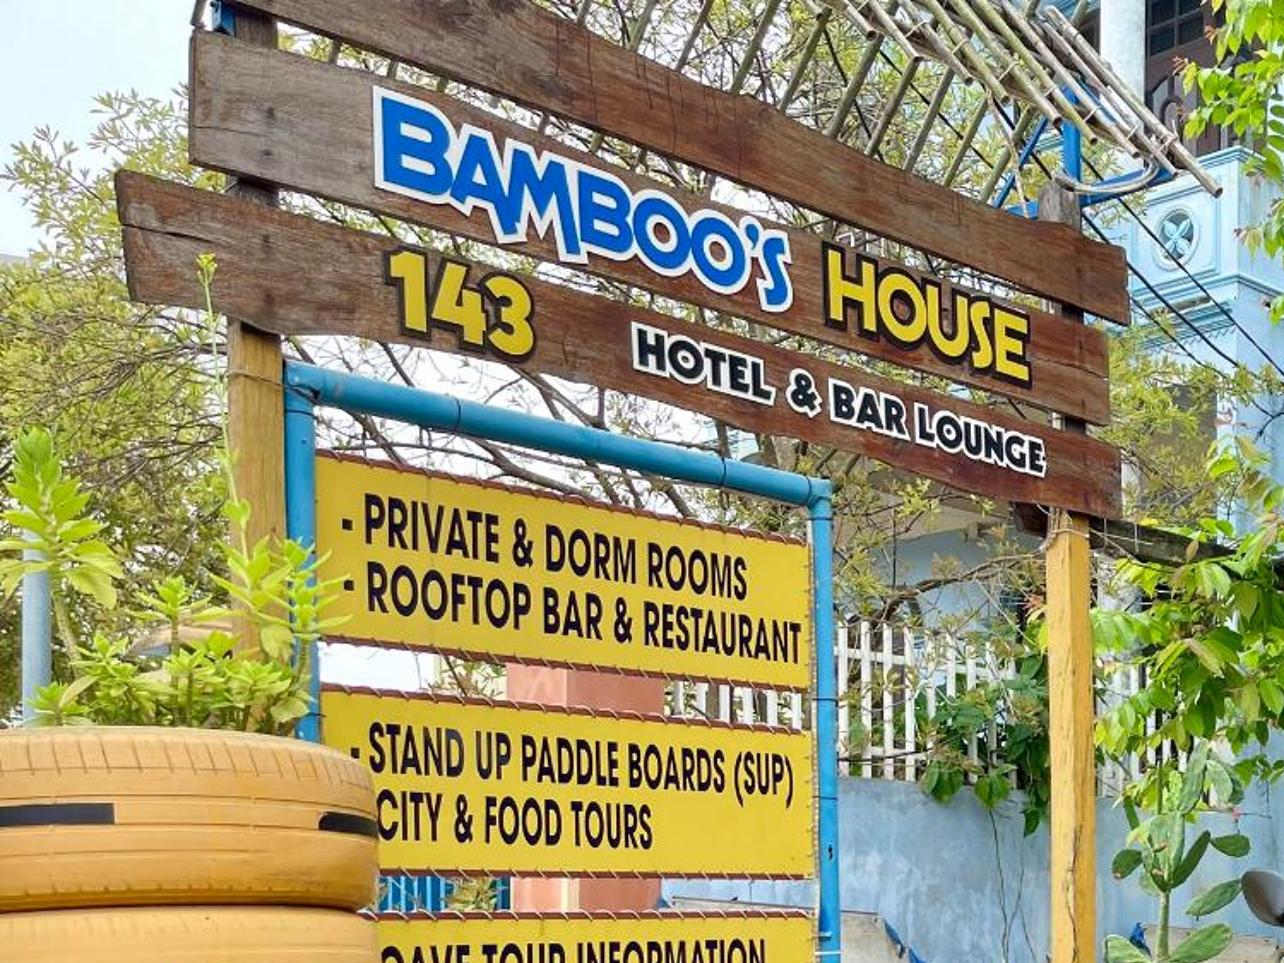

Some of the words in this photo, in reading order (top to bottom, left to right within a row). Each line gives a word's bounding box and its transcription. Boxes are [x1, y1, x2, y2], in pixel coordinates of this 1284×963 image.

[380, 94, 791, 308] BAMBOO'S
[827, 249, 1030, 381] HOUSE
[389, 250, 534, 356] 143
[636, 327, 772, 401] HOTEL
[789, 372, 818, 412] &
[832, 382, 907, 435] BAR
[917, 406, 1045, 474] LOUNGE
[364, 492, 500, 564] PRIVATE
[512, 518, 534, 568] &
[545, 523, 636, 585] DORM
[647, 542, 747, 601] ROOMS
[367, 561, 532, 630] ROOFTOP
[543, 586, 603, 641] BAR
[613, 597, 633, 644] &
[643, 601, 801, 664] RESTAURANT
[369, 721, 465, 778] STAND
[475, 730, 511, 780] UP
[521, 734, 619, 787] PADDLE
[628, 743, 725, 793] BOARDS
[734, 751, 793, 808] (SUP)
[377, 788, 443, 842] CITY
[454, 794, 473, 843] &
[485, 796, 562, 846] FOOD
[570, 800, 653, 850] TOURS
